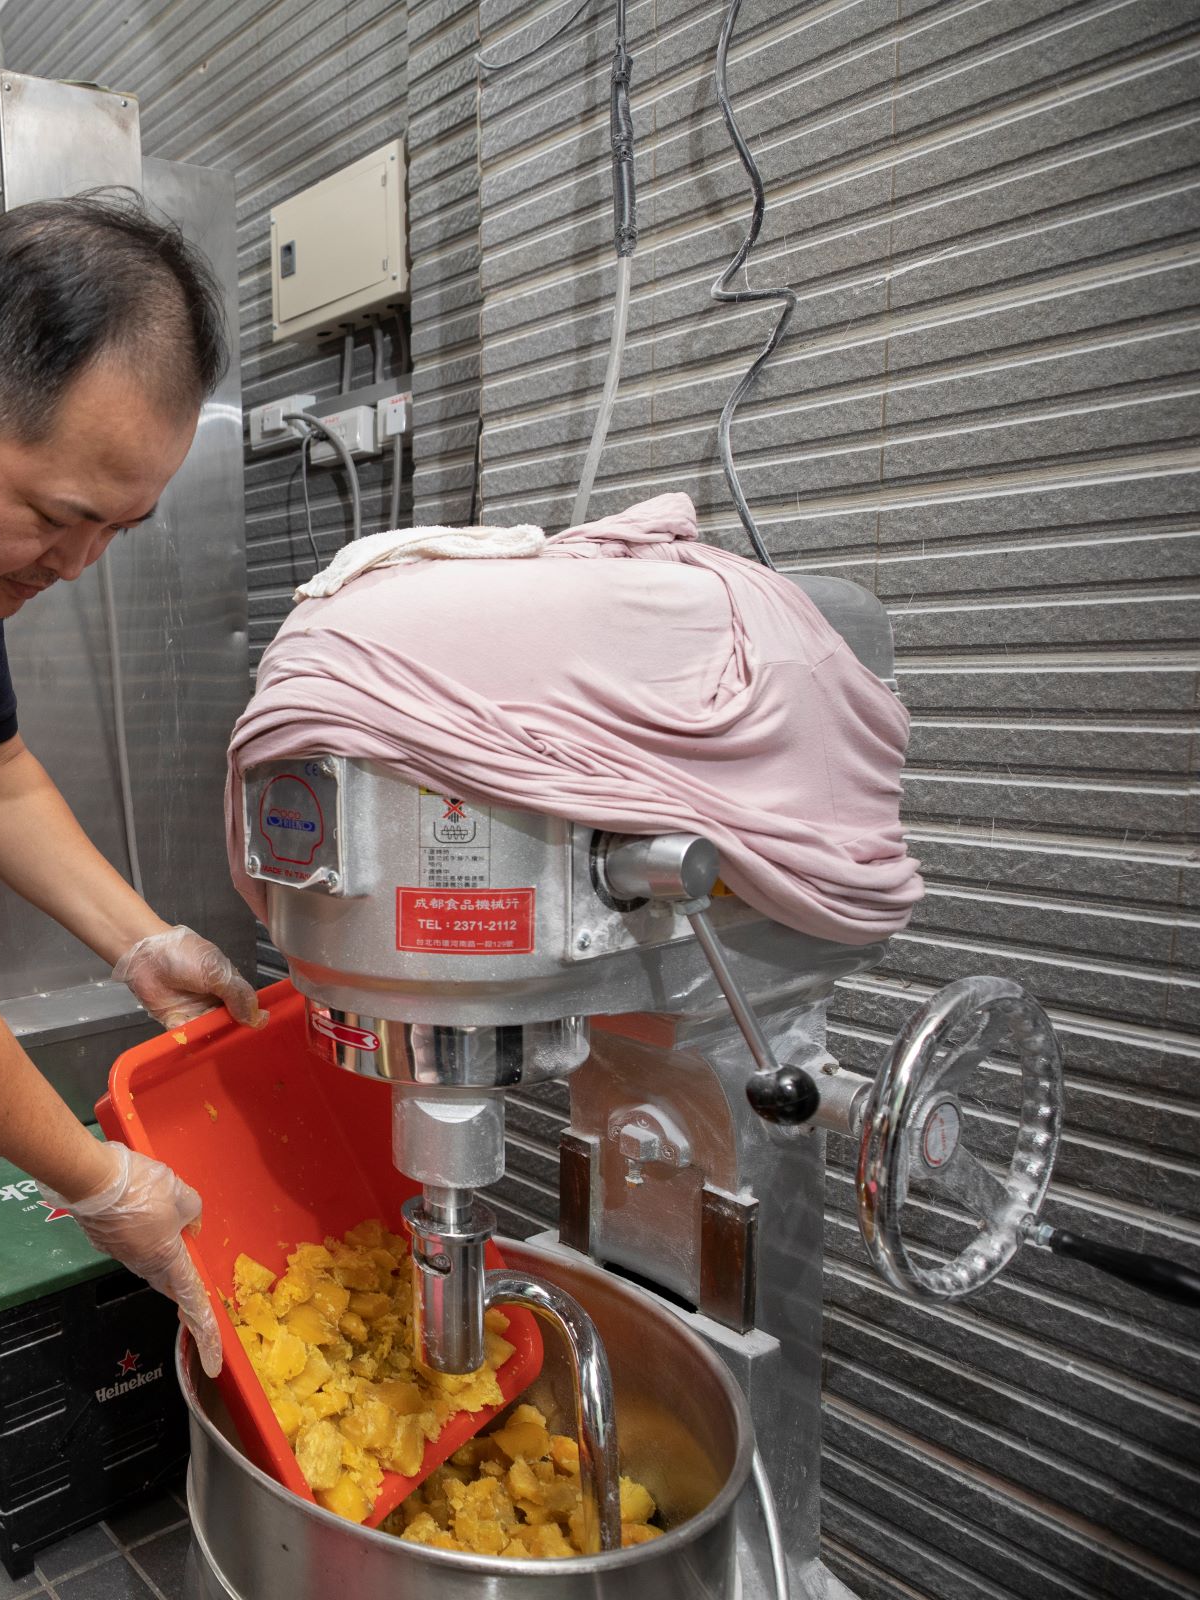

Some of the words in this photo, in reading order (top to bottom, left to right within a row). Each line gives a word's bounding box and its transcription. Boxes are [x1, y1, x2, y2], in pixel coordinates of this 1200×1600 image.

[262, 864, 284, 876] MADE
[284, 869, 293, 877] IN
[414, 897, 520, 911] 成都食品機械行
[453, 920, 517, 931] 2371-2112
[21, 1204, 39, 1213] 1873
[95, 1367, 164, 1403] Heineken
